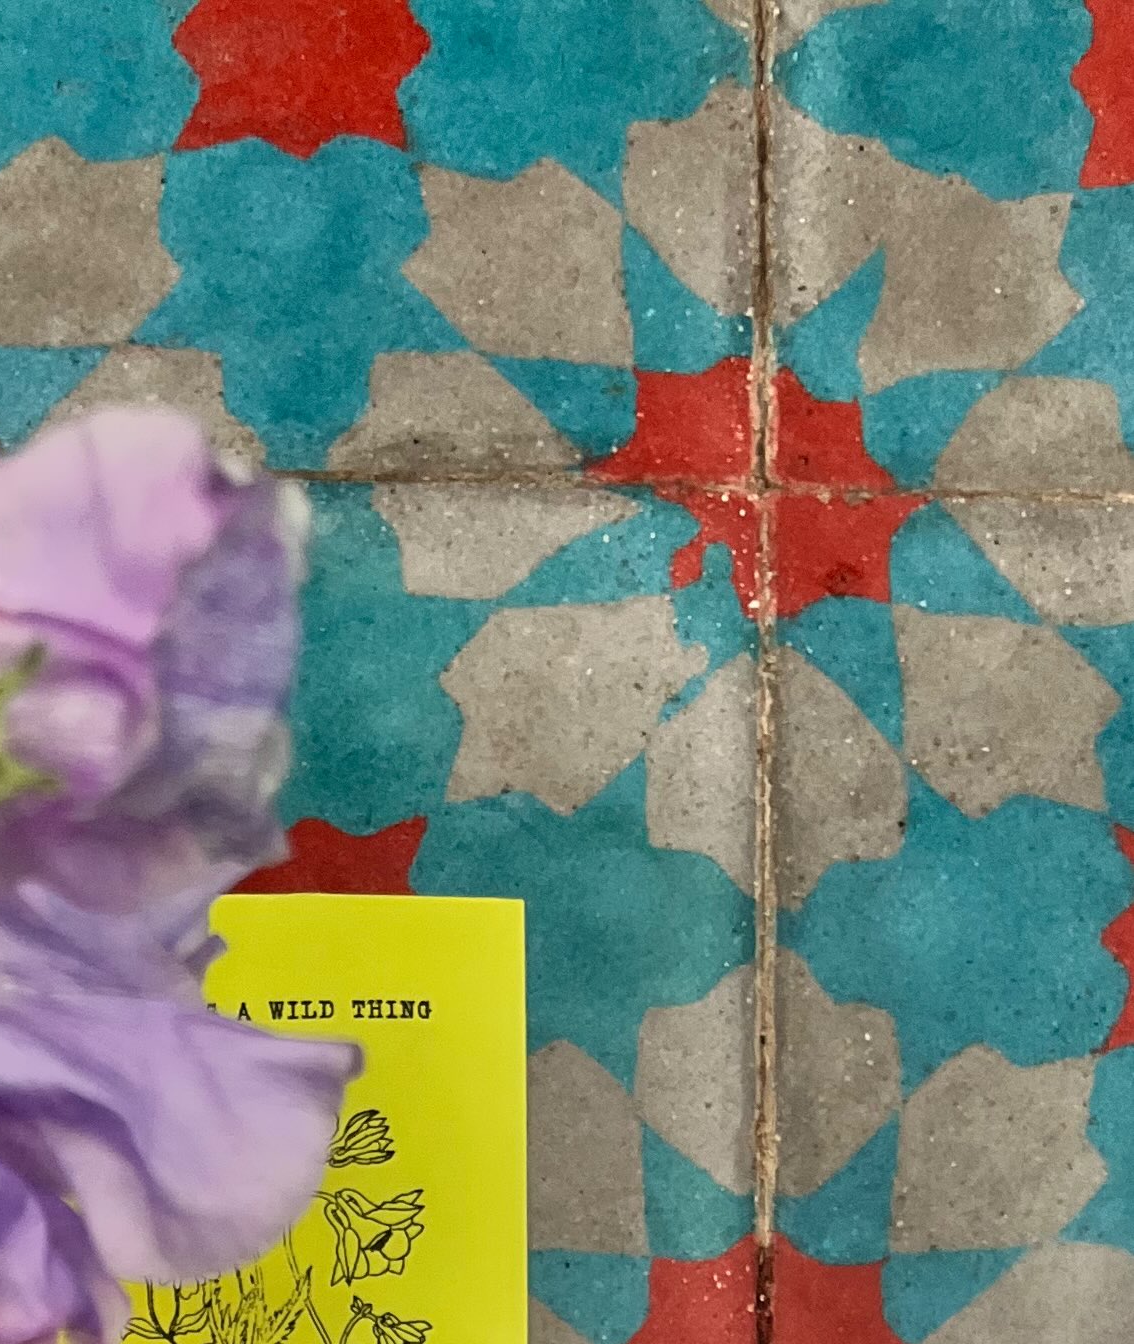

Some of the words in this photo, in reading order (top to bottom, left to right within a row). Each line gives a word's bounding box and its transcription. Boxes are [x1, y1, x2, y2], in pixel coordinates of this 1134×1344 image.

[237, 1001, 253, 1021] A
[268, 1000, 335, 1020] WILD
[351, 999, 432, 1020] THING
